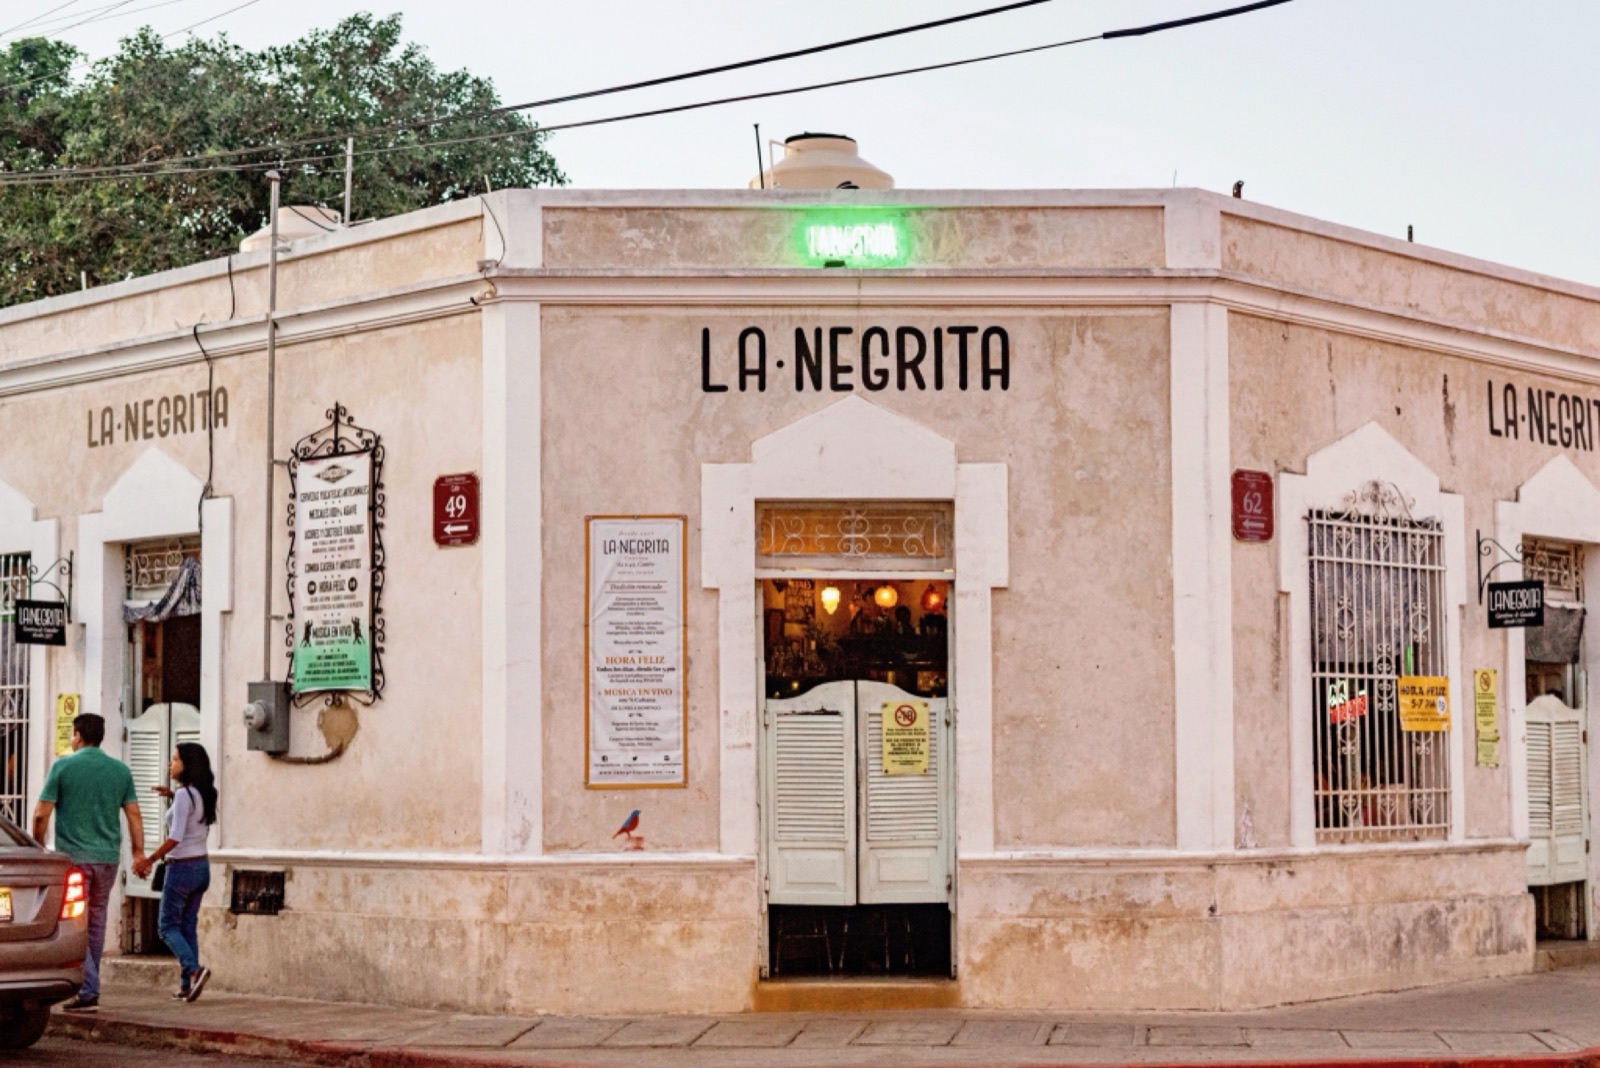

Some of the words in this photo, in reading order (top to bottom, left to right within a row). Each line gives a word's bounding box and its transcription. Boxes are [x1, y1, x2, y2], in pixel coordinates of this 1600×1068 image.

[445, 494, 467, 518] 49
[1243, 491, 1262, 514] 62
[605, 656, 636, 665] HORA
[638, 656, 665, 665] FELIZ
[651, 687, 673, 696] VIVO
